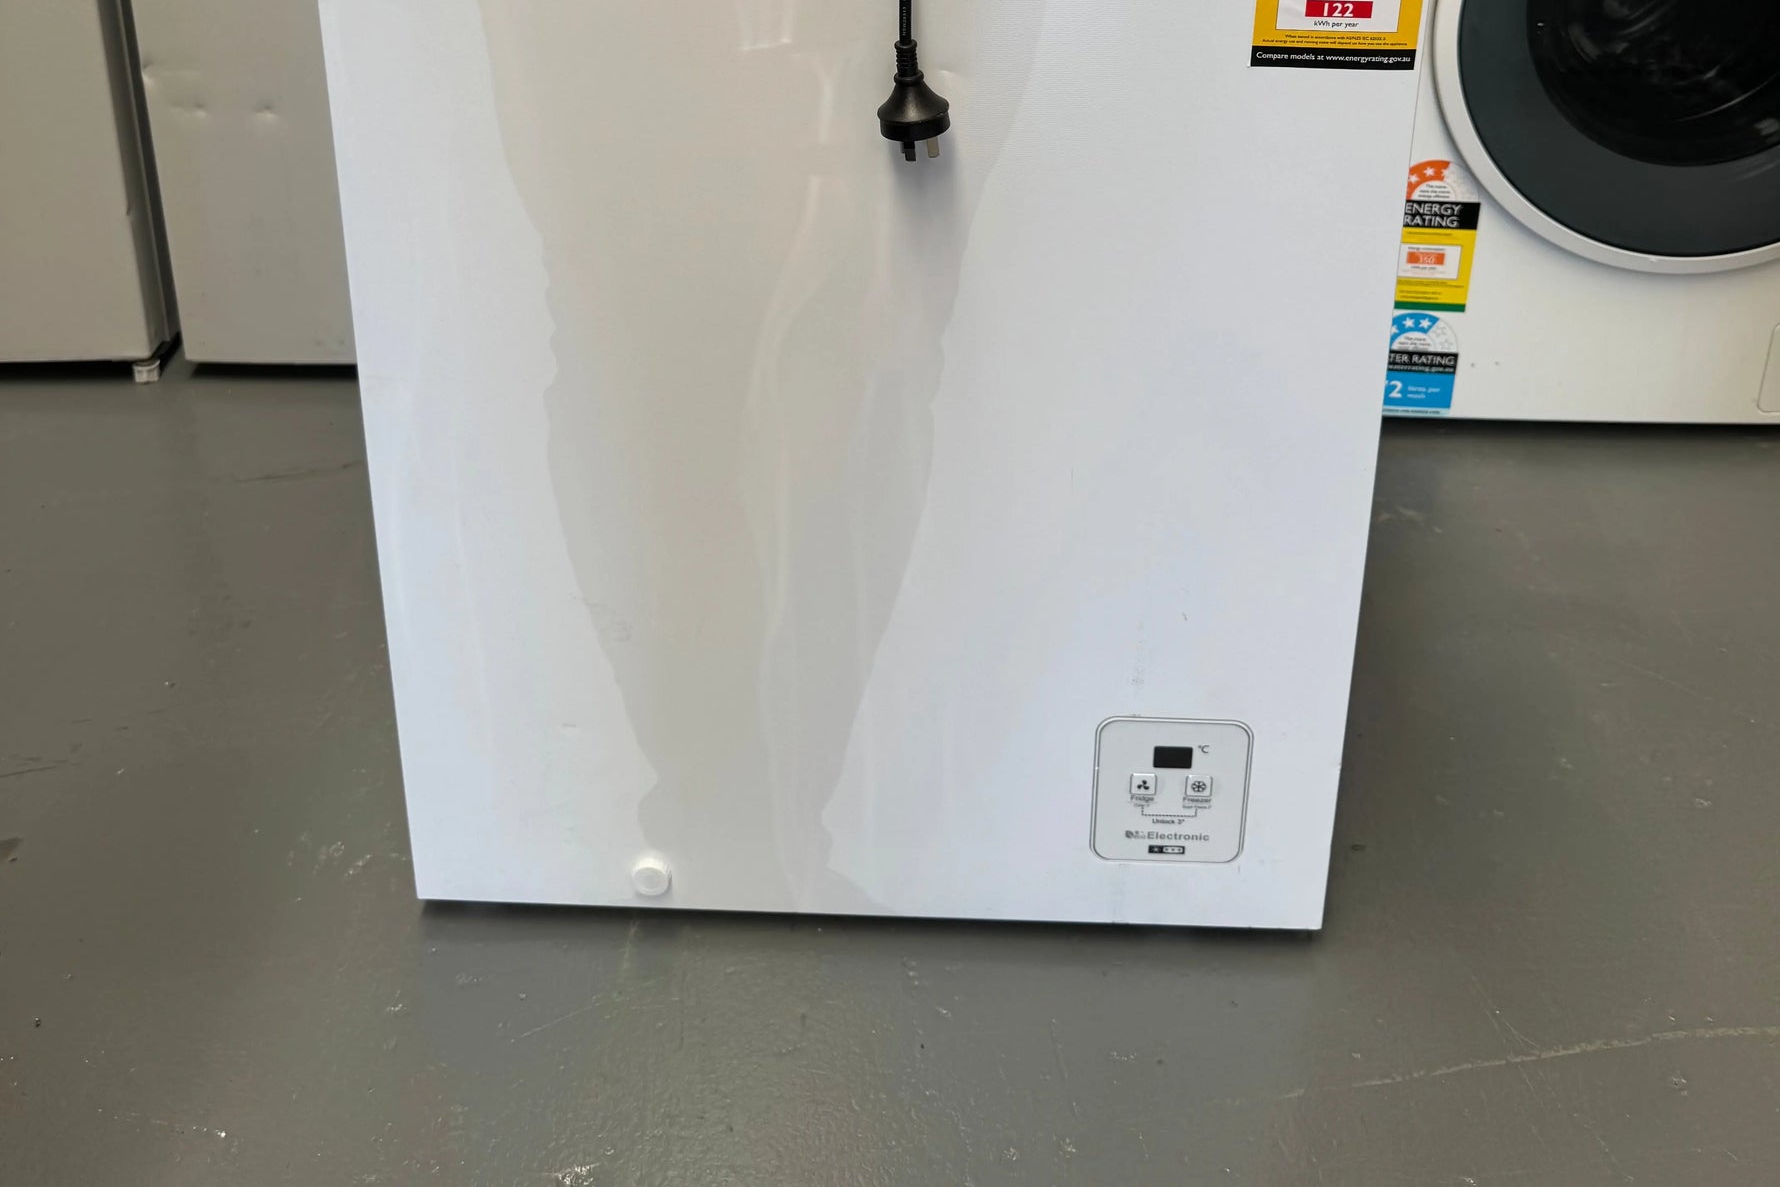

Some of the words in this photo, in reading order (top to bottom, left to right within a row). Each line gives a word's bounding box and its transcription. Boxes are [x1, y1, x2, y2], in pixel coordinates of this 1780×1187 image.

[1323, 2, 1354, 17] 122
[1256, 51, 1288, 60] Compare
[1325, 55, 1411, 63] www.energyrating.gov.au
[1405, 201, 1462, 215] ENERGY
[1403, 214, 1459, 228] RATING
[1389, 353, 1410, 364] TER
[1411, 354, 1455, 366] RATING
[1385, 380, 1402, 398] 2
[1198, 744, 1210, 754] °C
[1147, 831, 1210, 841] Electronic
